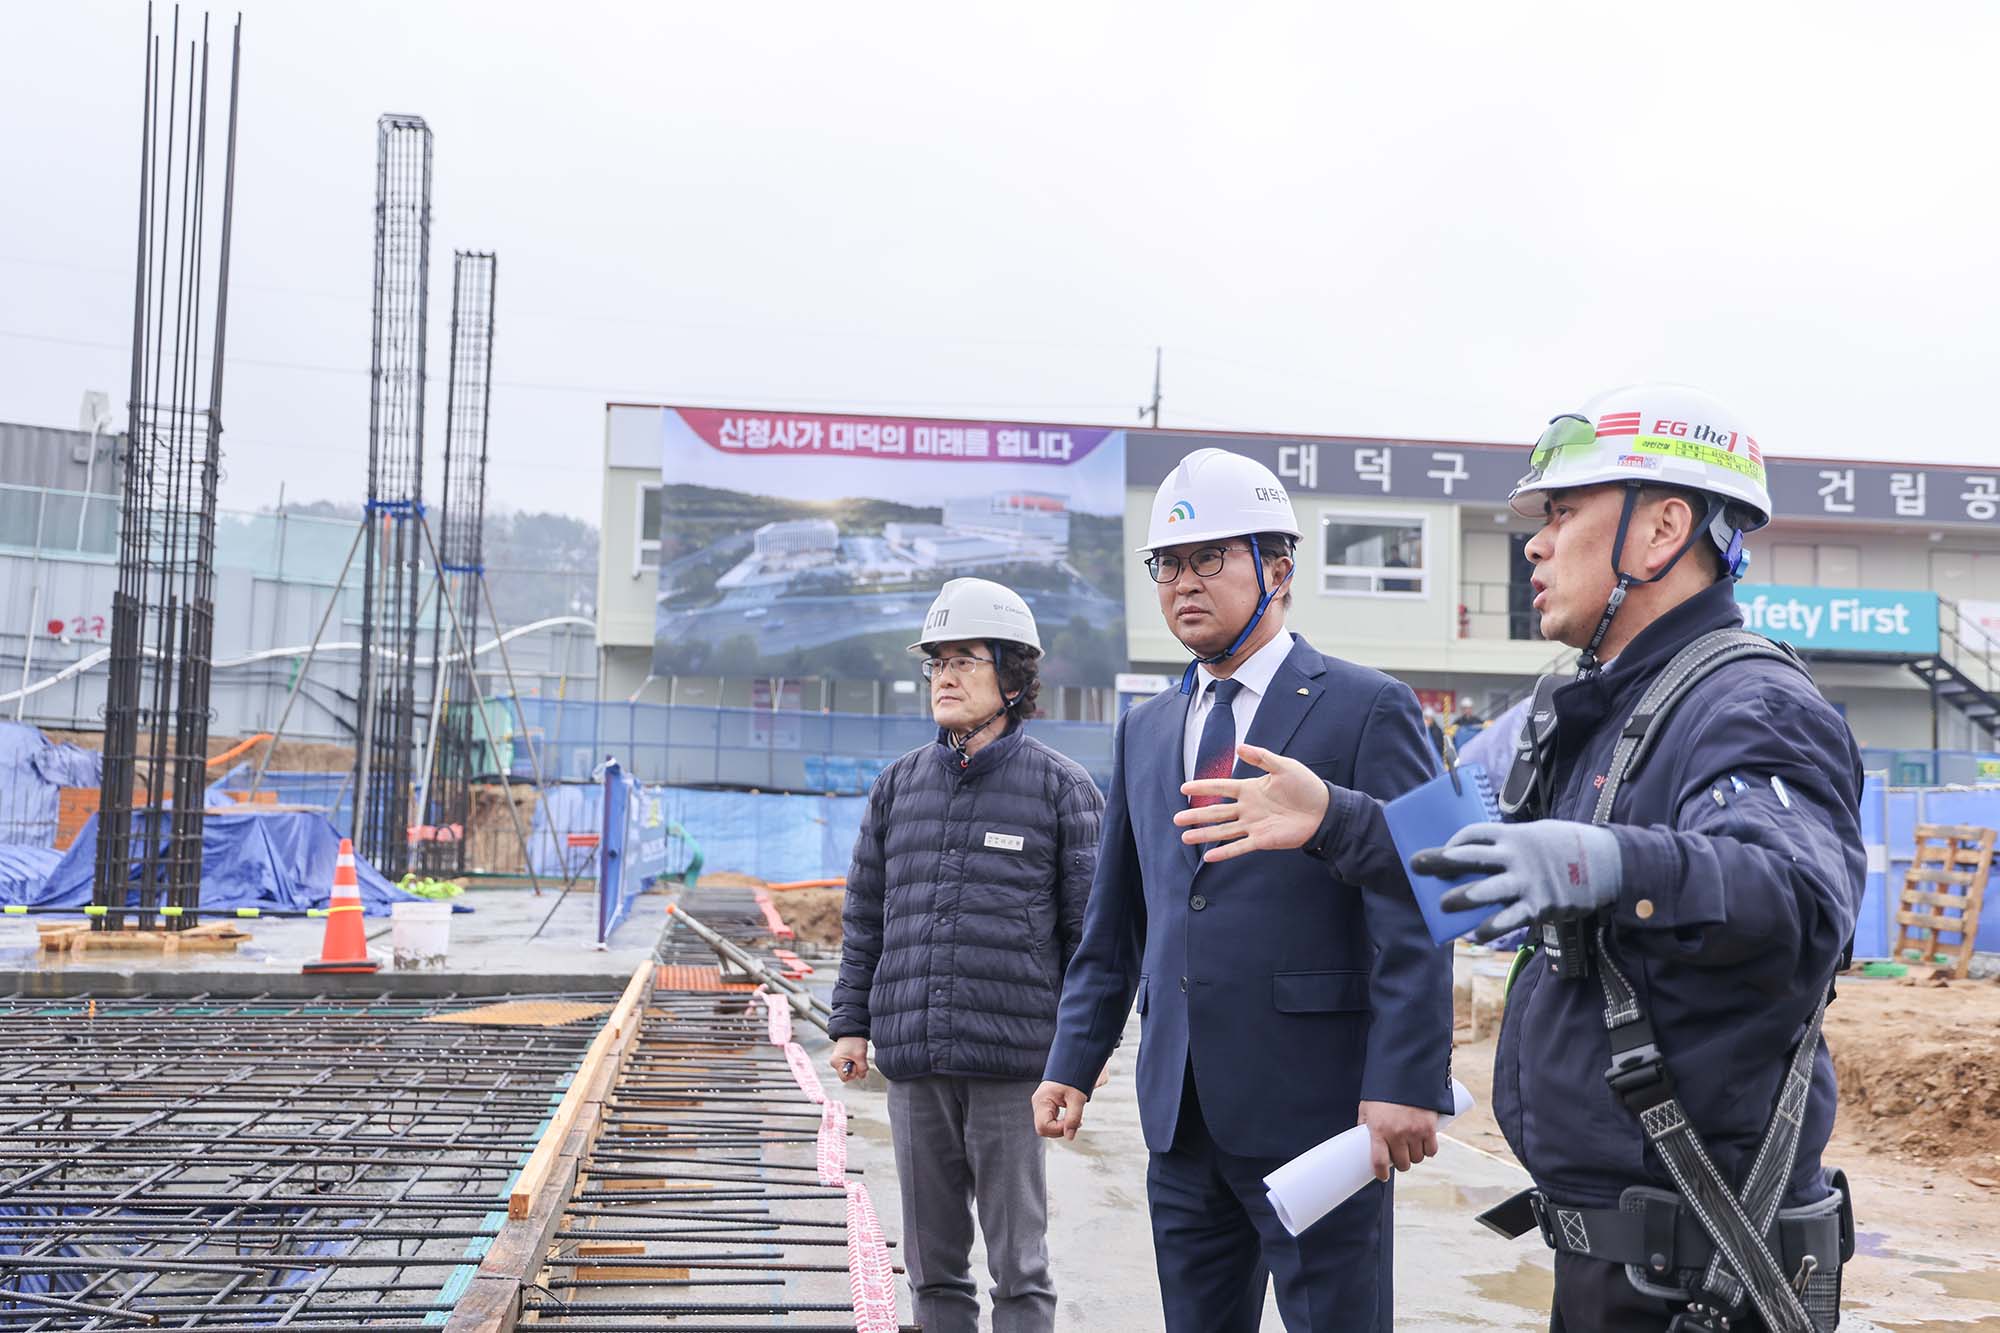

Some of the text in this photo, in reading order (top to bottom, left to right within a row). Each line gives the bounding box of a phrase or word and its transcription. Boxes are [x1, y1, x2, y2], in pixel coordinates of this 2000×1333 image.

[718, 417, 1075, 461] 신청사가 대덕의 미래를 엽니다
[1652, 419, 1689, 437] EG
[1278, 443, 1470, 496] 대덕구
[1736, 595, 1911, 639] afety First
